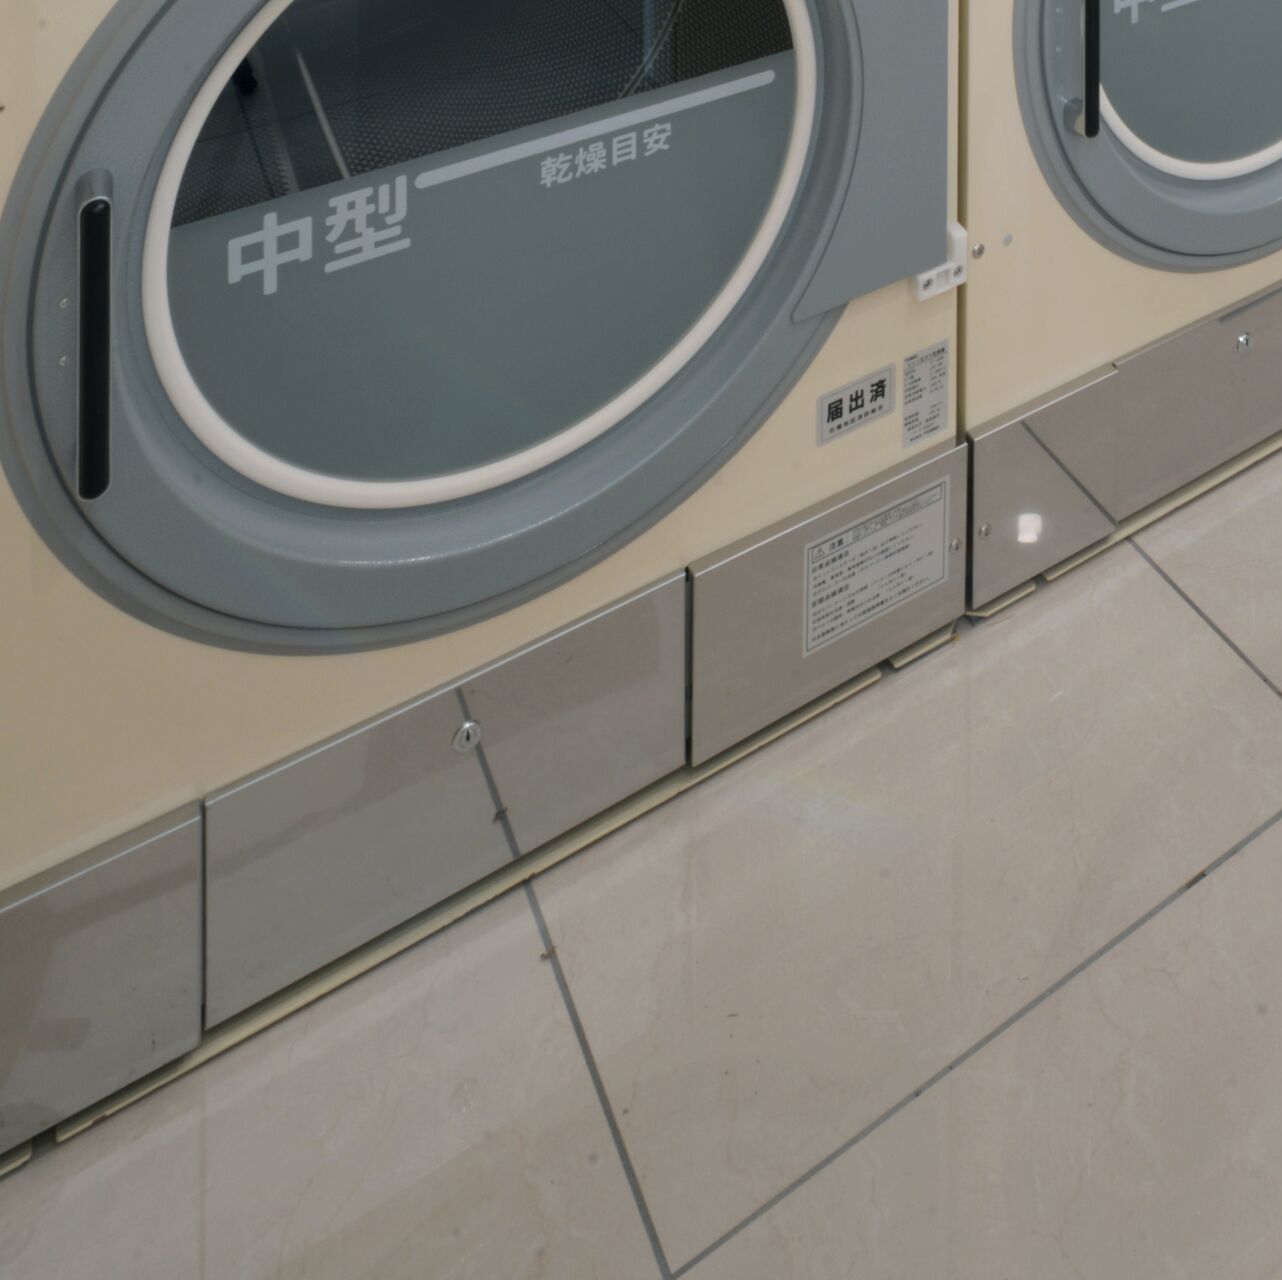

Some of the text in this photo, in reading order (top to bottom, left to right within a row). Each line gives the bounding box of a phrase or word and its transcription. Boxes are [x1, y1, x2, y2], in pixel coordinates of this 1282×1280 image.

[538, 121, 673, 188] 乾燥目安
[227, 174, 412, 296] 中型
[827, 378, 886, 423] 届出済
